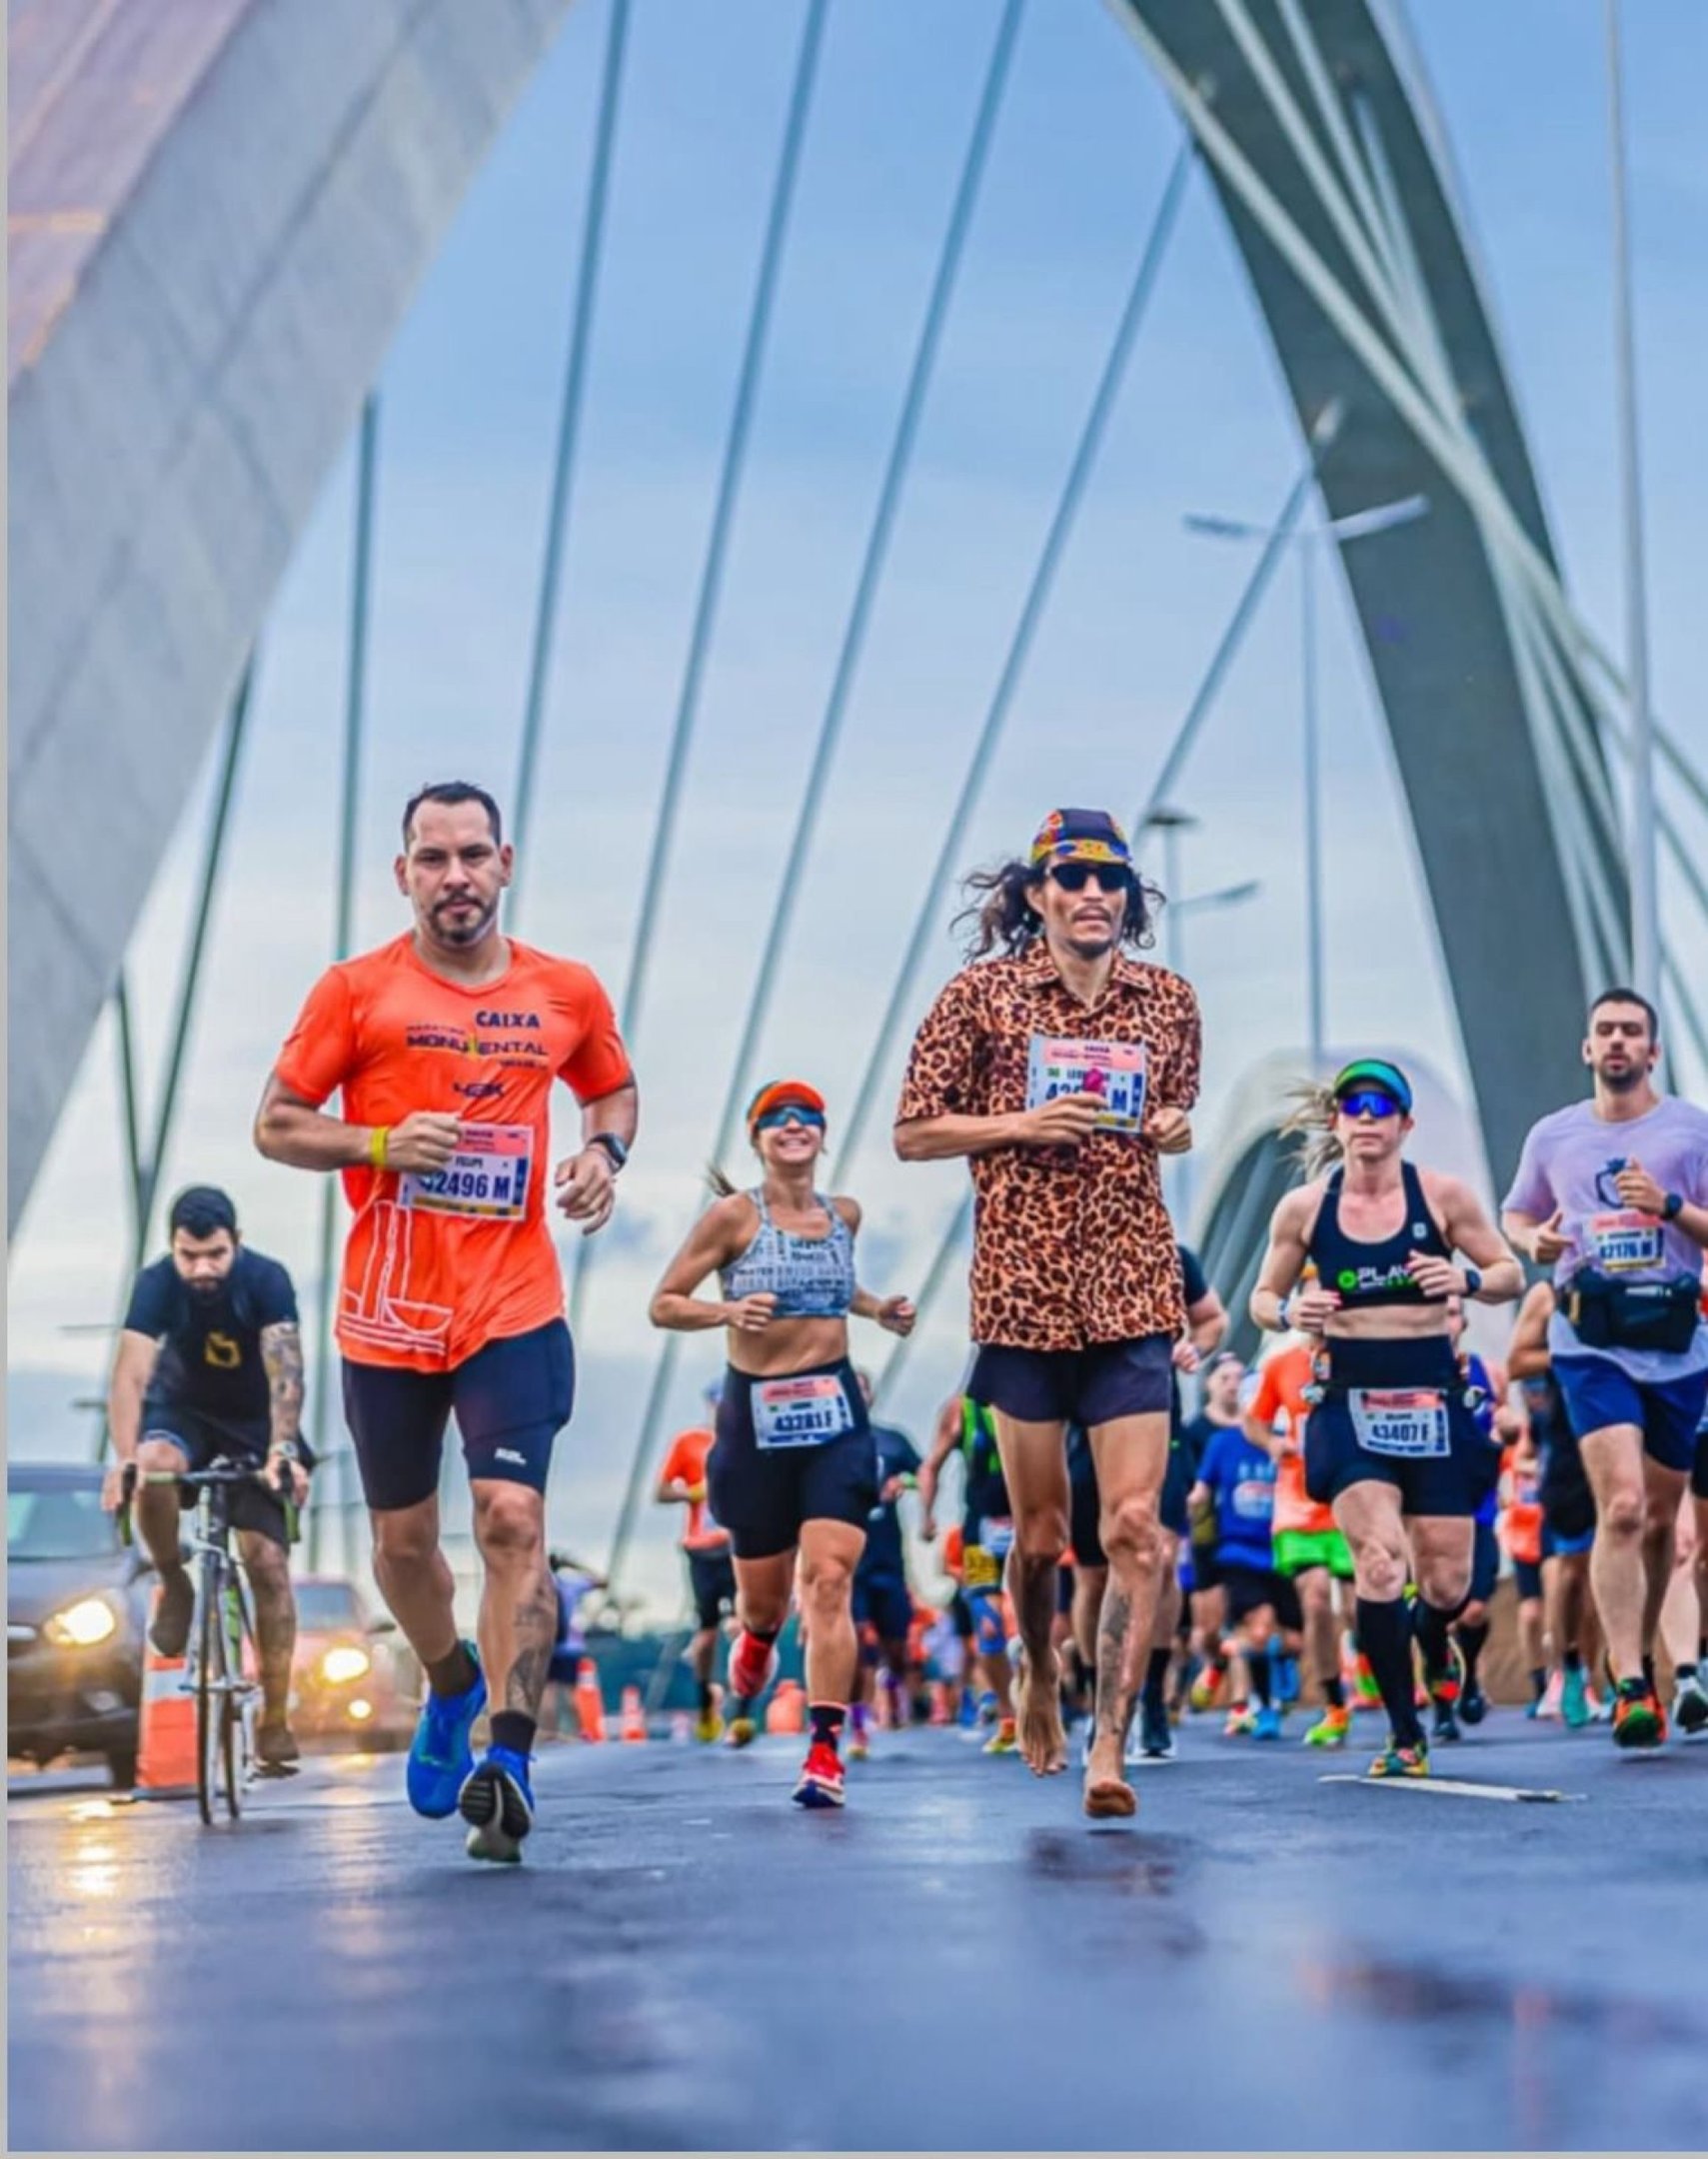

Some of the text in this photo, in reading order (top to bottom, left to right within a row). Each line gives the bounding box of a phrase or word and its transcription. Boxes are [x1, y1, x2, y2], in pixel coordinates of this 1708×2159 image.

[476, 1011, 540, 1028] CAIXA
[1111, 1088, 1127, 1111] M
[493, 1175, 511, 1199] M
